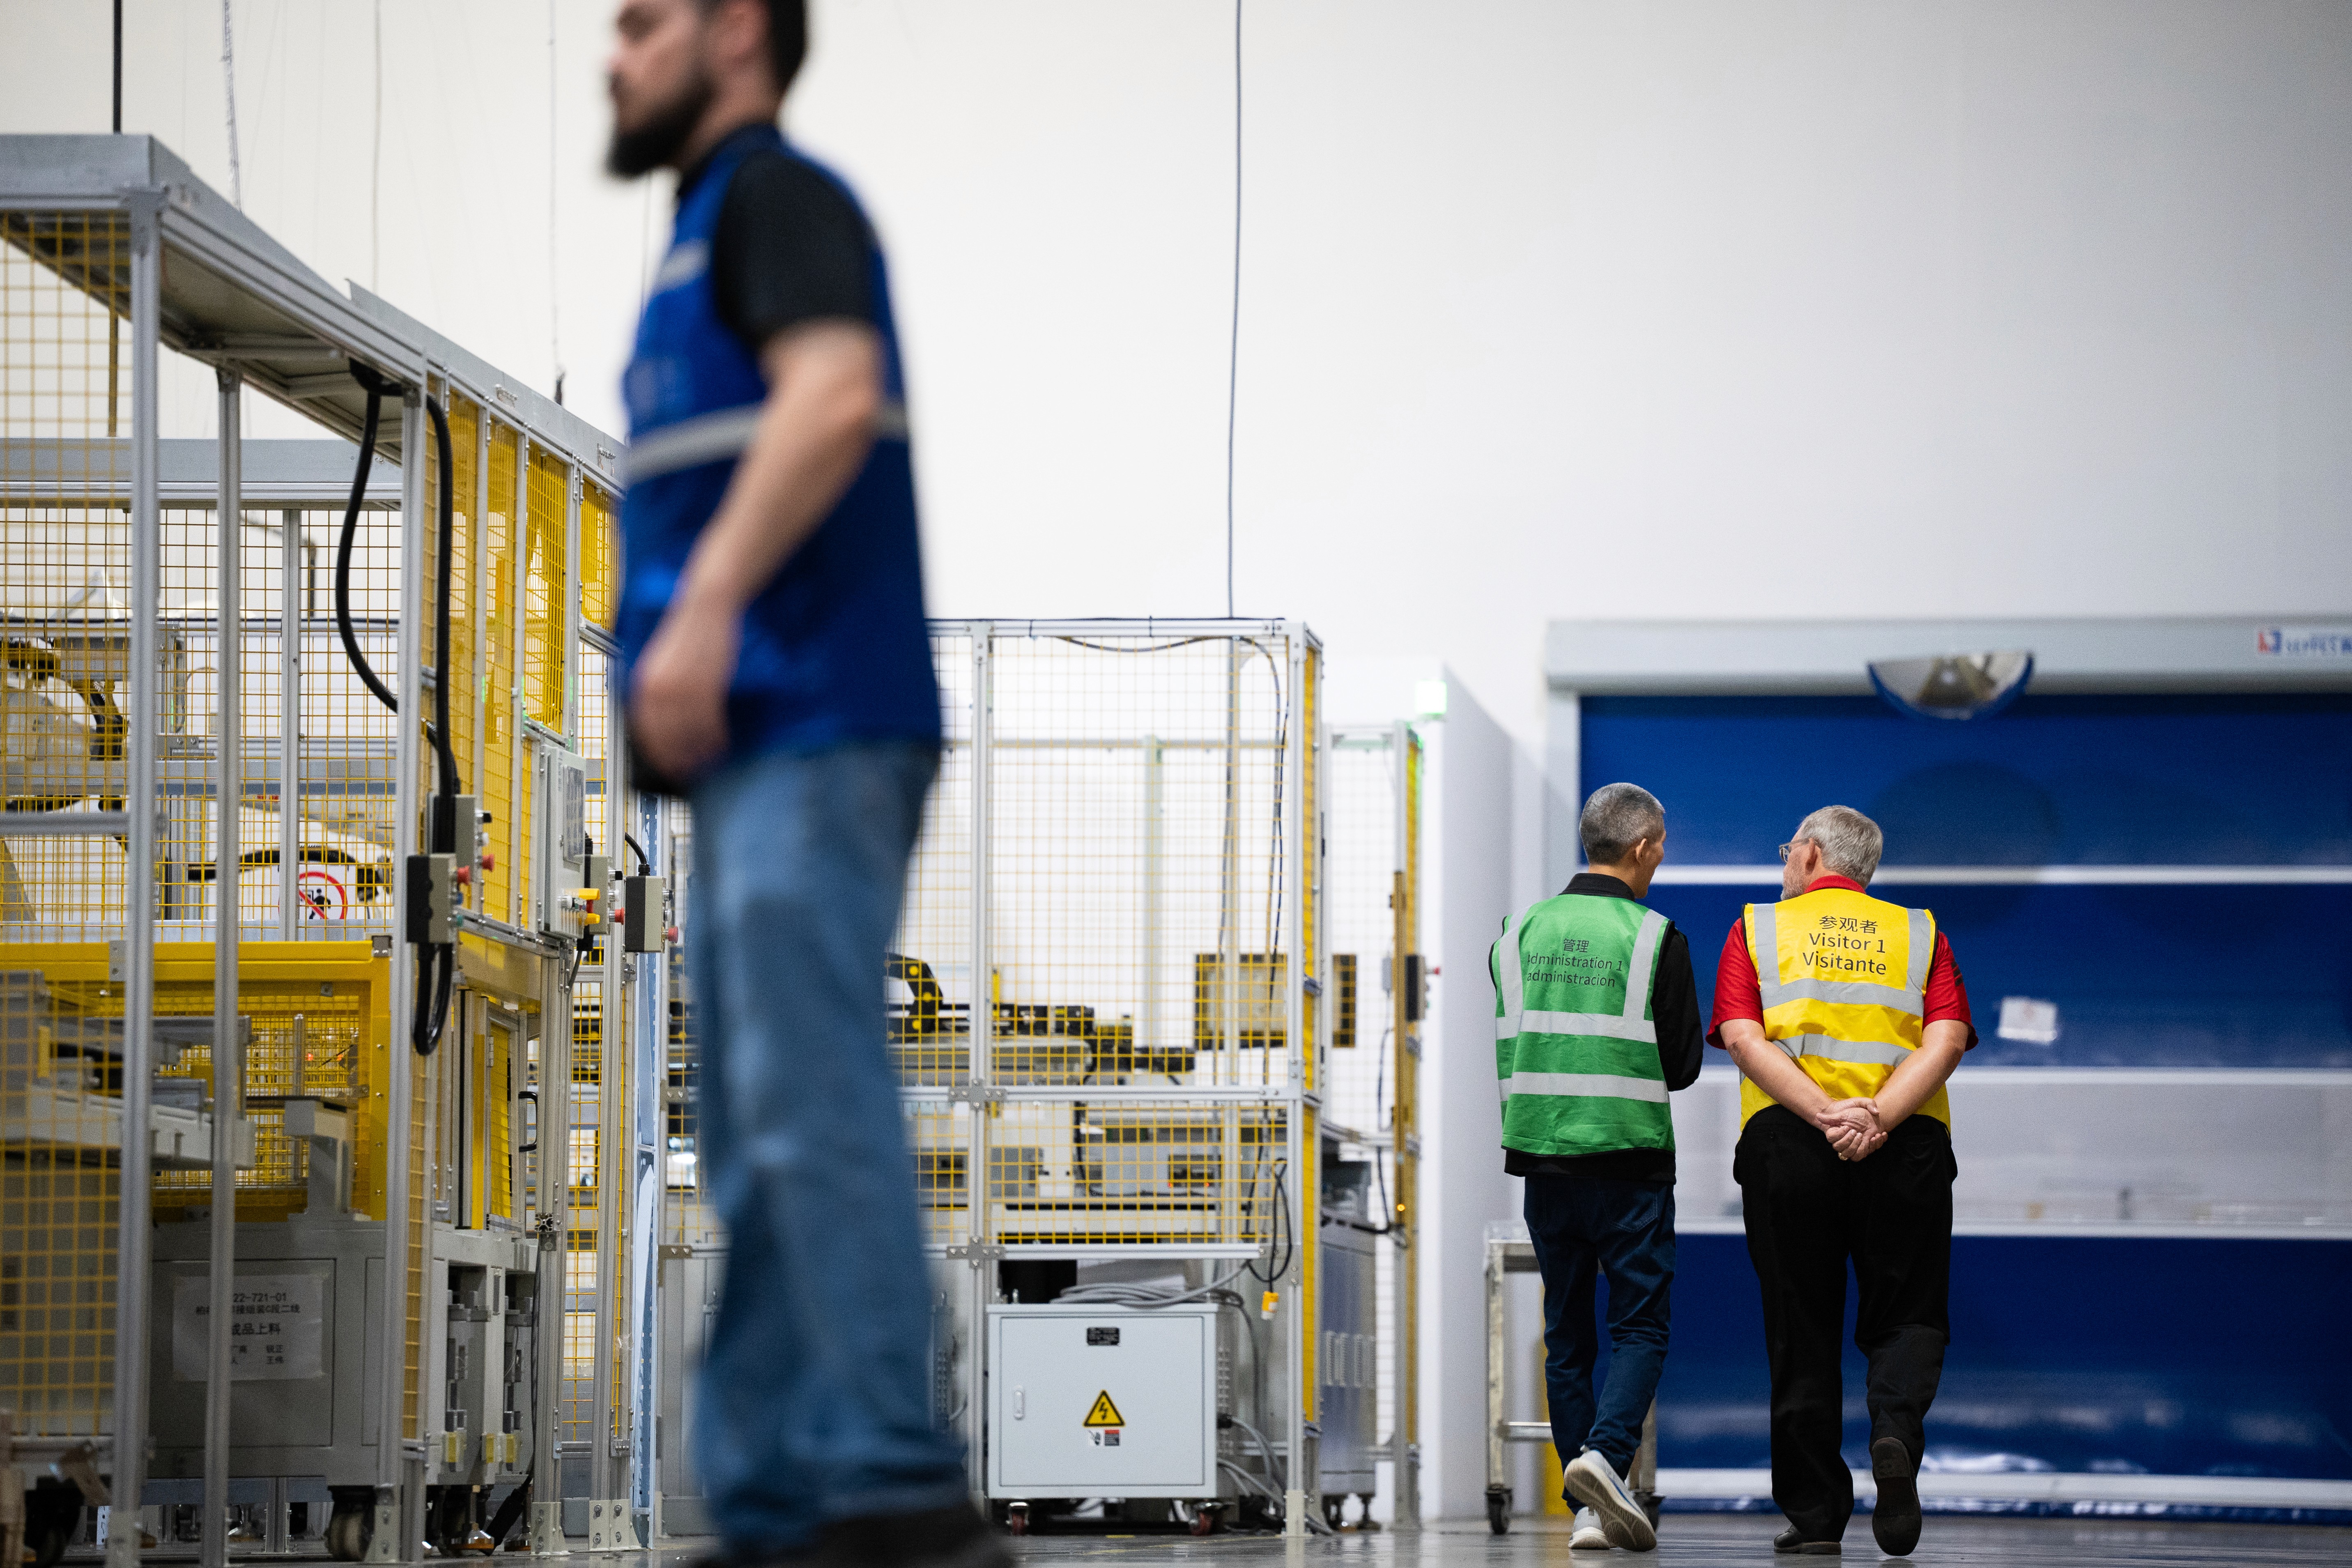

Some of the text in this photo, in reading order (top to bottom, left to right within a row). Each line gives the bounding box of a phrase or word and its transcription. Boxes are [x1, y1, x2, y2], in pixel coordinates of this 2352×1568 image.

[1819, 915, 1878, 934] 参观者
[1563, 938, 1589, 953] 管理
[1809, 932, 1885, 953] Visitor 1
[1527, 953, 1622, 971] Administration 1
[1803, 951, 1887, 975] Visitante
[1527, 970, 1615, 988] administracion
